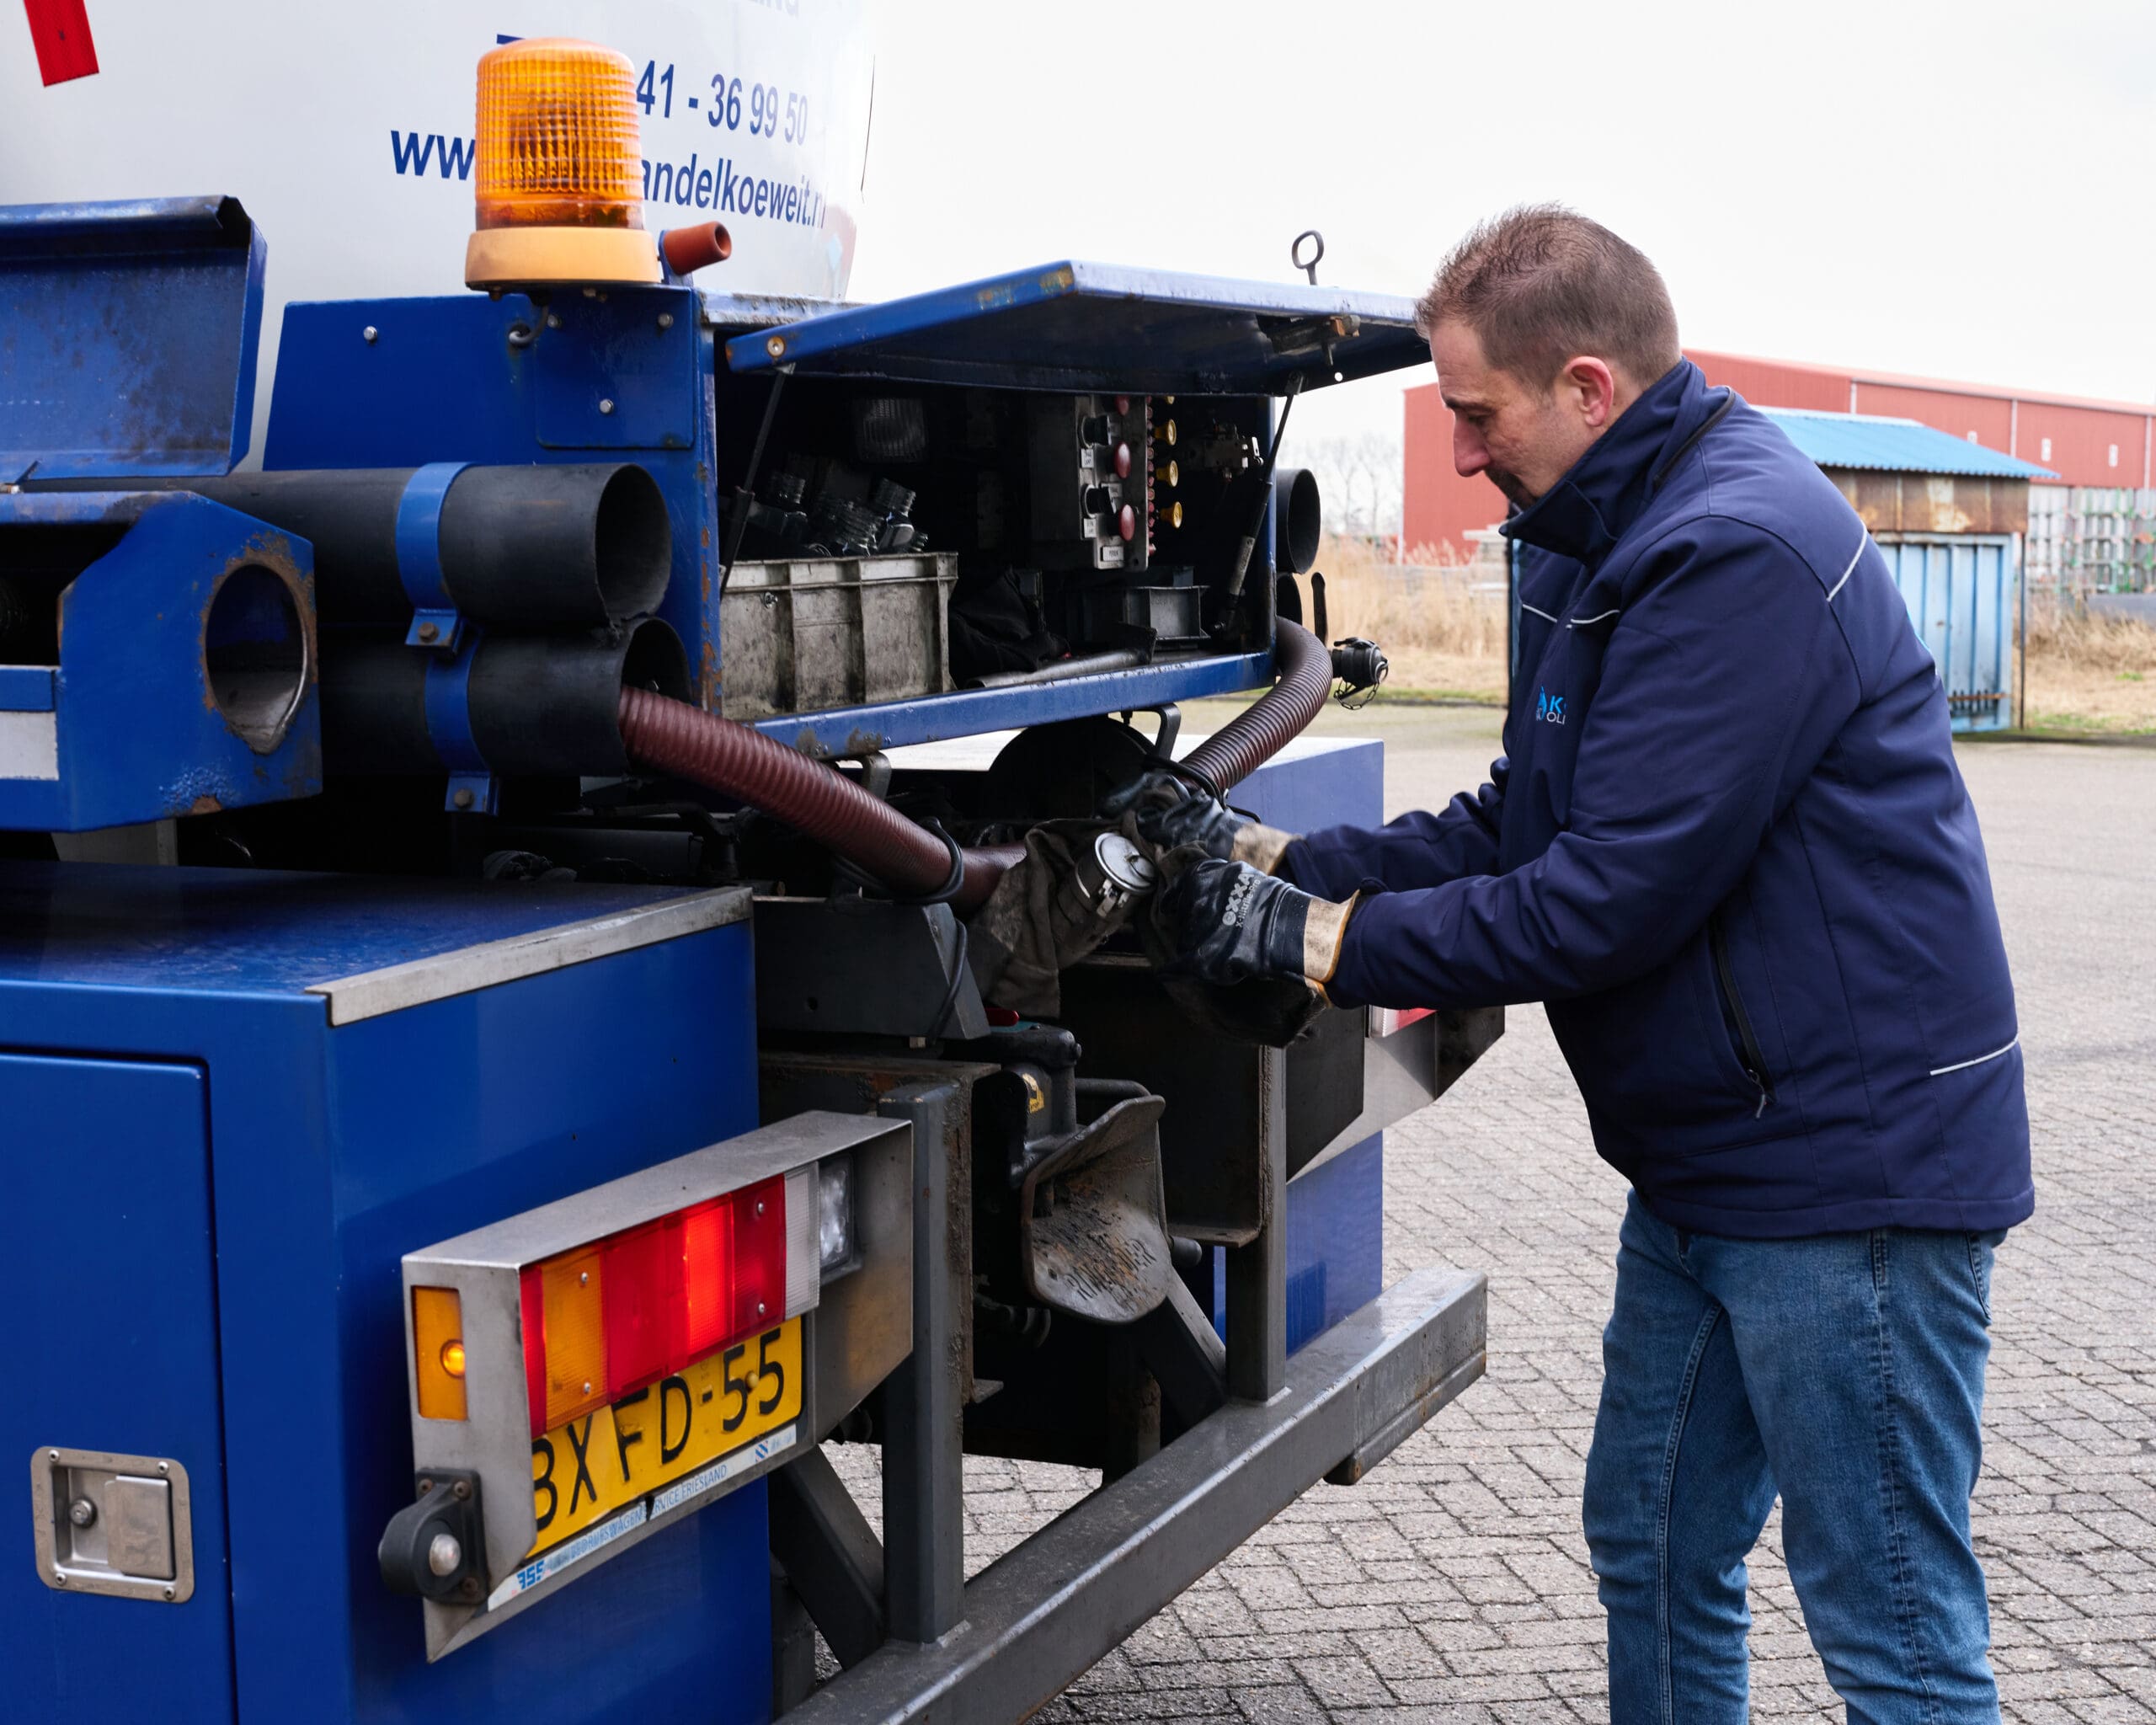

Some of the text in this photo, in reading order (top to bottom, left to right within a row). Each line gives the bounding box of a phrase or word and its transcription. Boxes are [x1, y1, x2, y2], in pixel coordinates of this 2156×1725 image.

[708, 73, 743, 131] 36
[750, 83, 779, 138] 99
[783, 92, 808, 146] 50
[1549, 694, 1567, 714] K
[1222, 873, 1255, 926] OXXA
